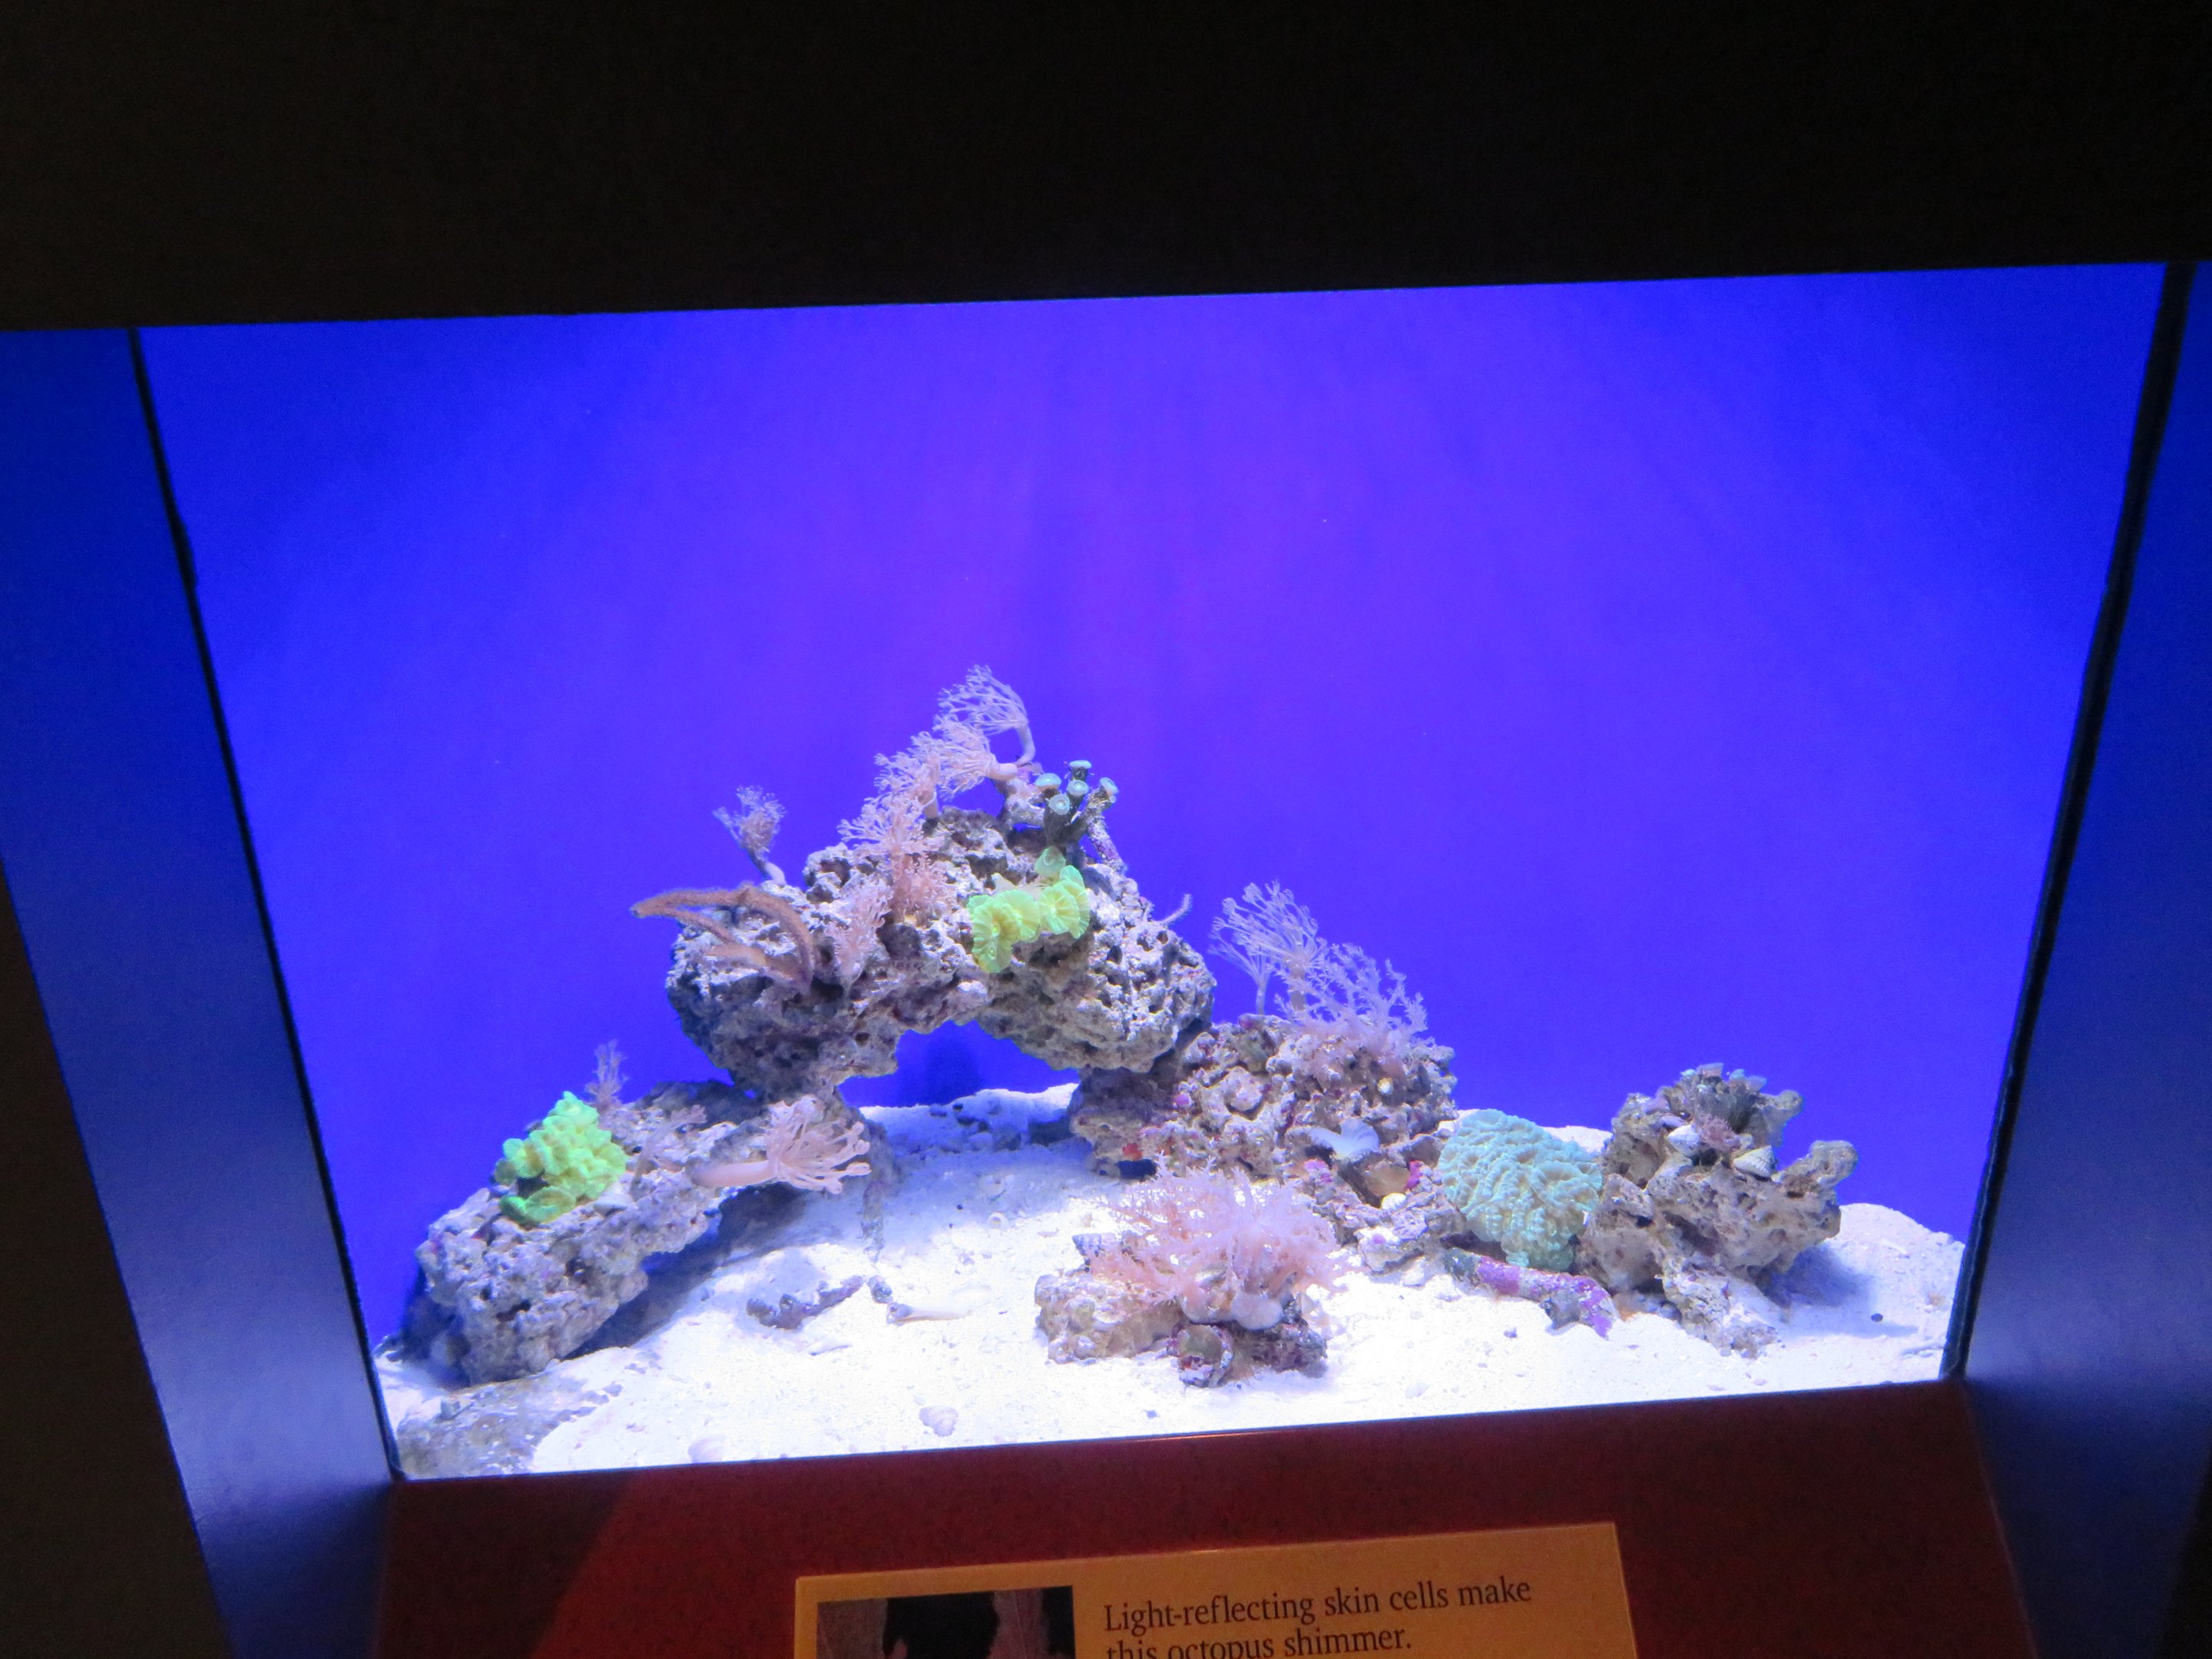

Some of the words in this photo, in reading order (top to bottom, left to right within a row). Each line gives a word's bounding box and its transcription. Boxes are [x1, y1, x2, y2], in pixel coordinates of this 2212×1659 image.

[1104, 1594, 1315, 1637] Light-reflecting
[1325, 1587, 1380, 1616] skin
[1389, 1581, 1449, 1611] cells
[1458, 1576, 1531, 1606] make
[1106, 1641, 1157, 1659] this
[1167, 1639, 1274, 1659] octopus
[1284, 1628, 1412, 1657] shimmer.
